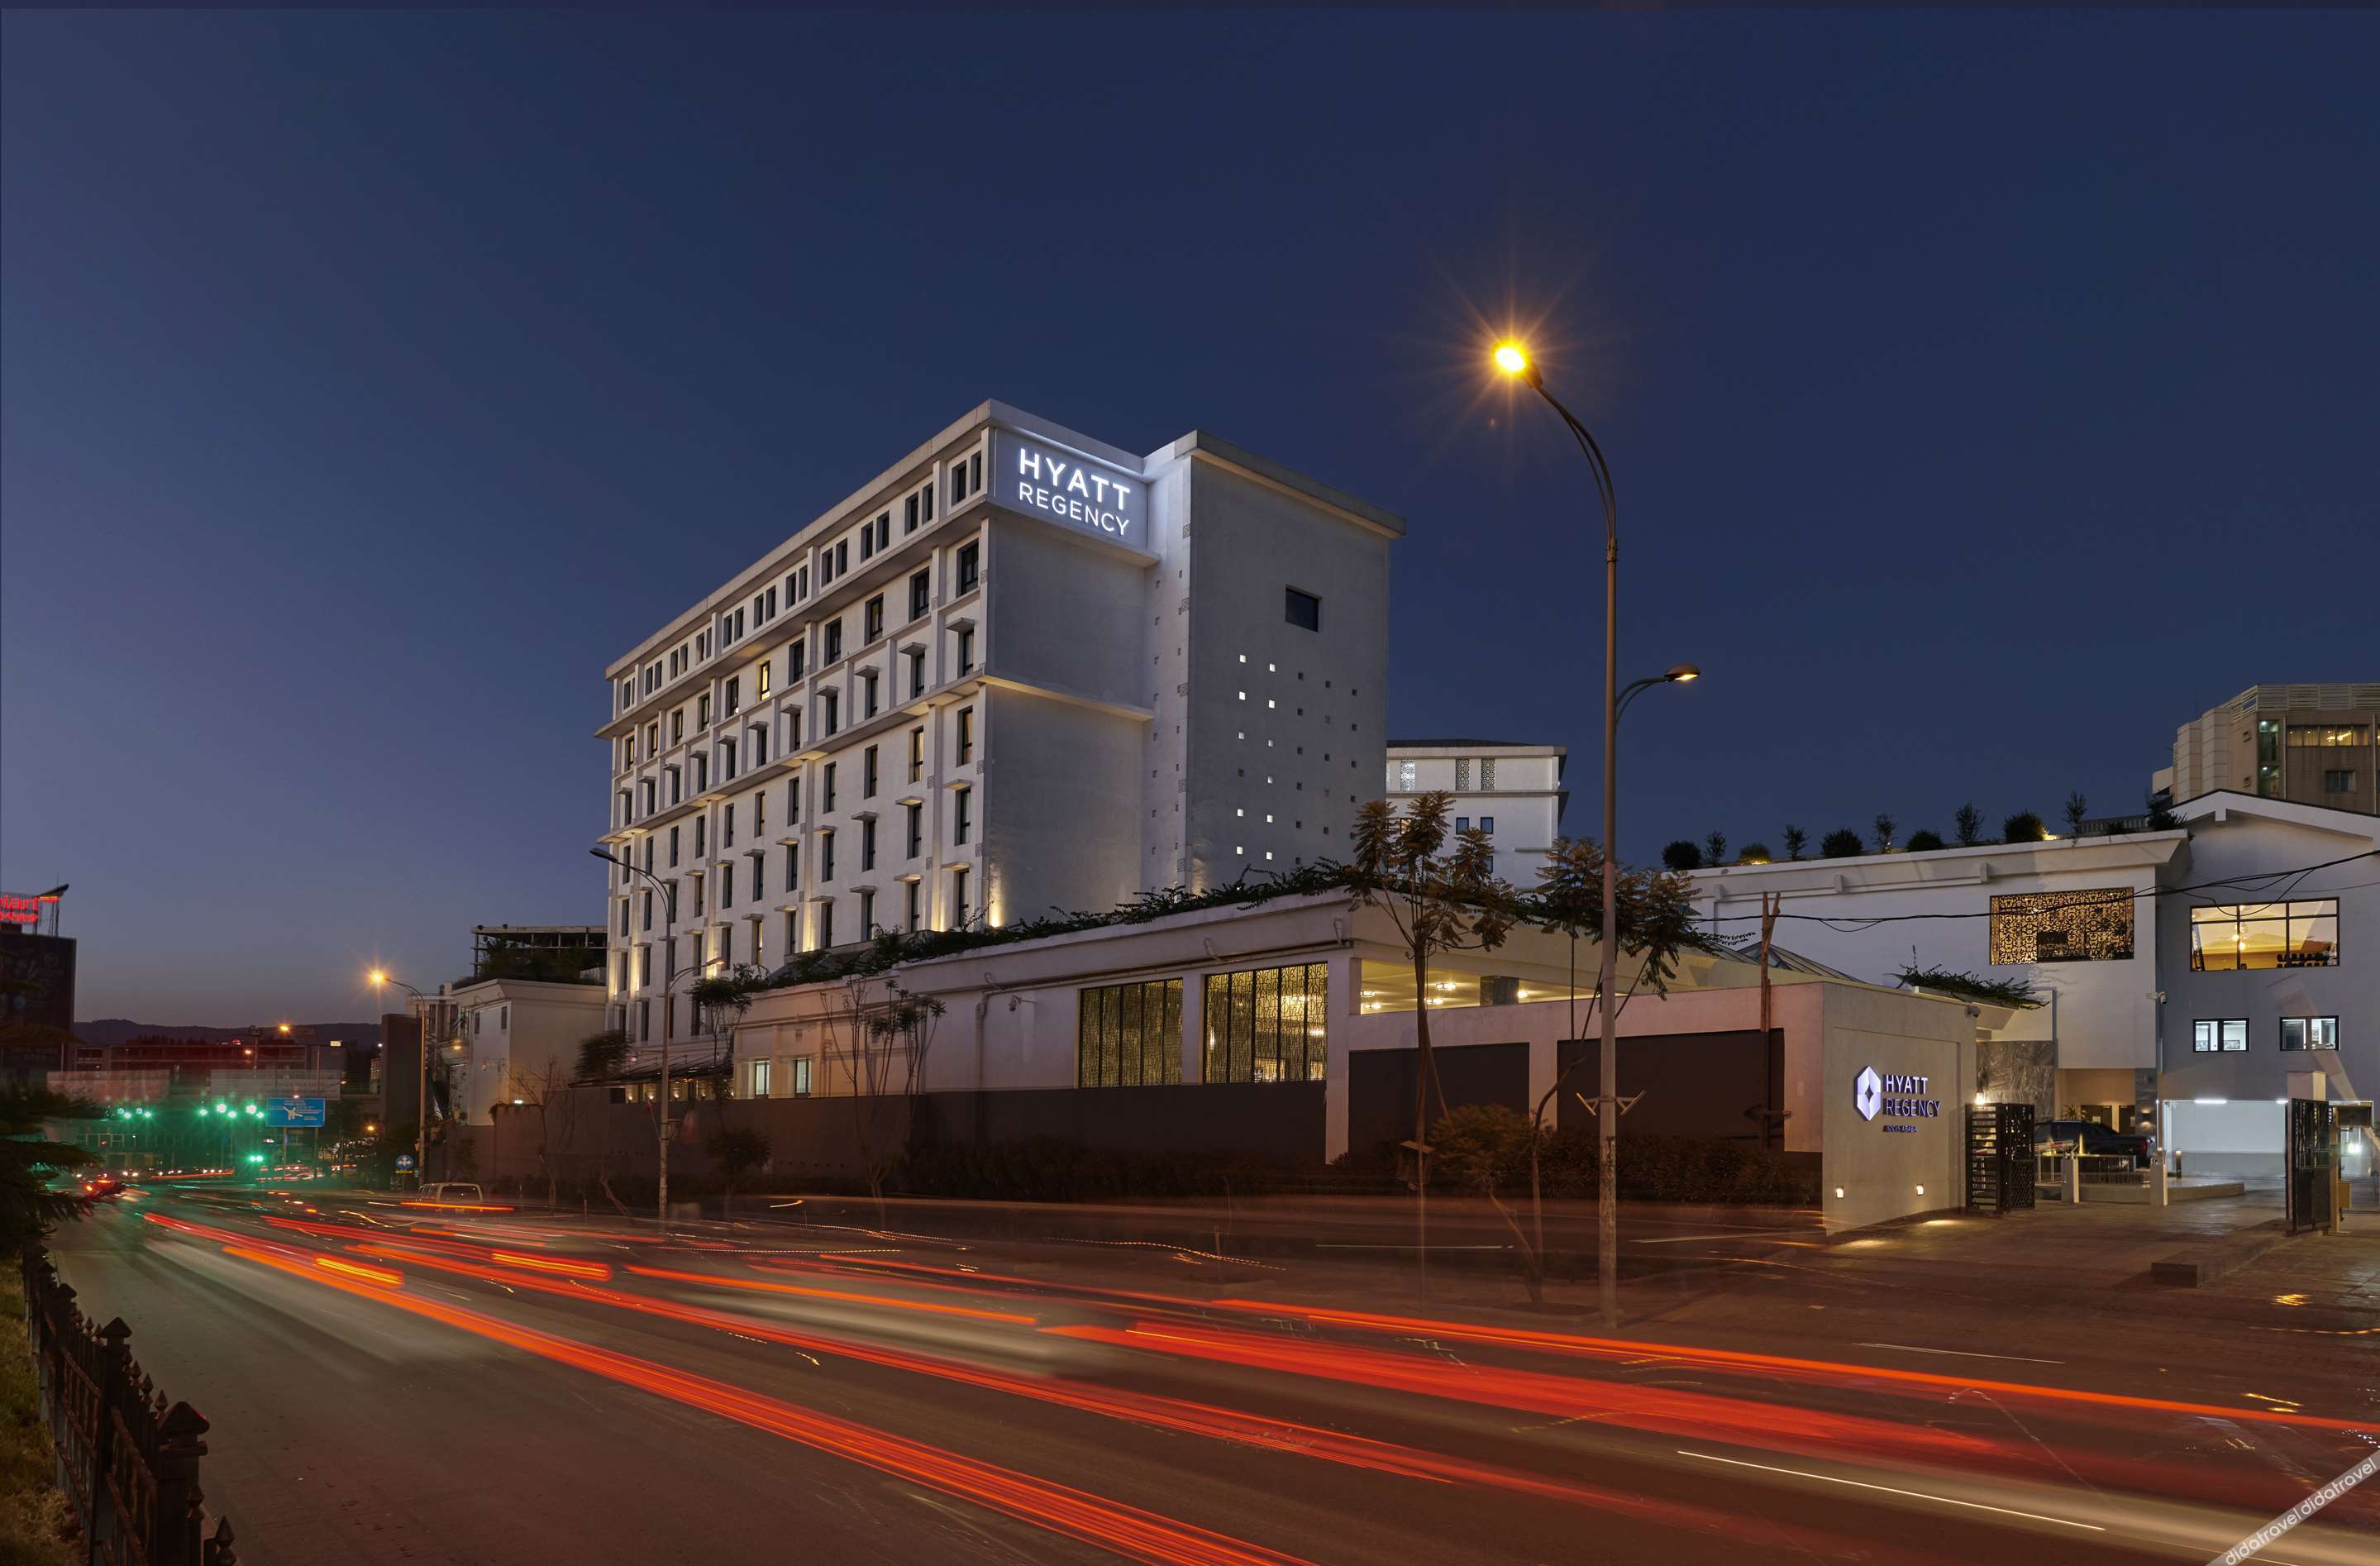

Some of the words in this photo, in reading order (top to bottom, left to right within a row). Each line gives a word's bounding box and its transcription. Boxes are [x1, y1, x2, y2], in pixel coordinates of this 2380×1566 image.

[1019, 447, 1131, 510] HYATT
[1019, 482, 1129, 536] REGENCY
[1885, 1074, 1929, 1095] HYATT
[1885, 1097, 1941, 1118] REGENCY
